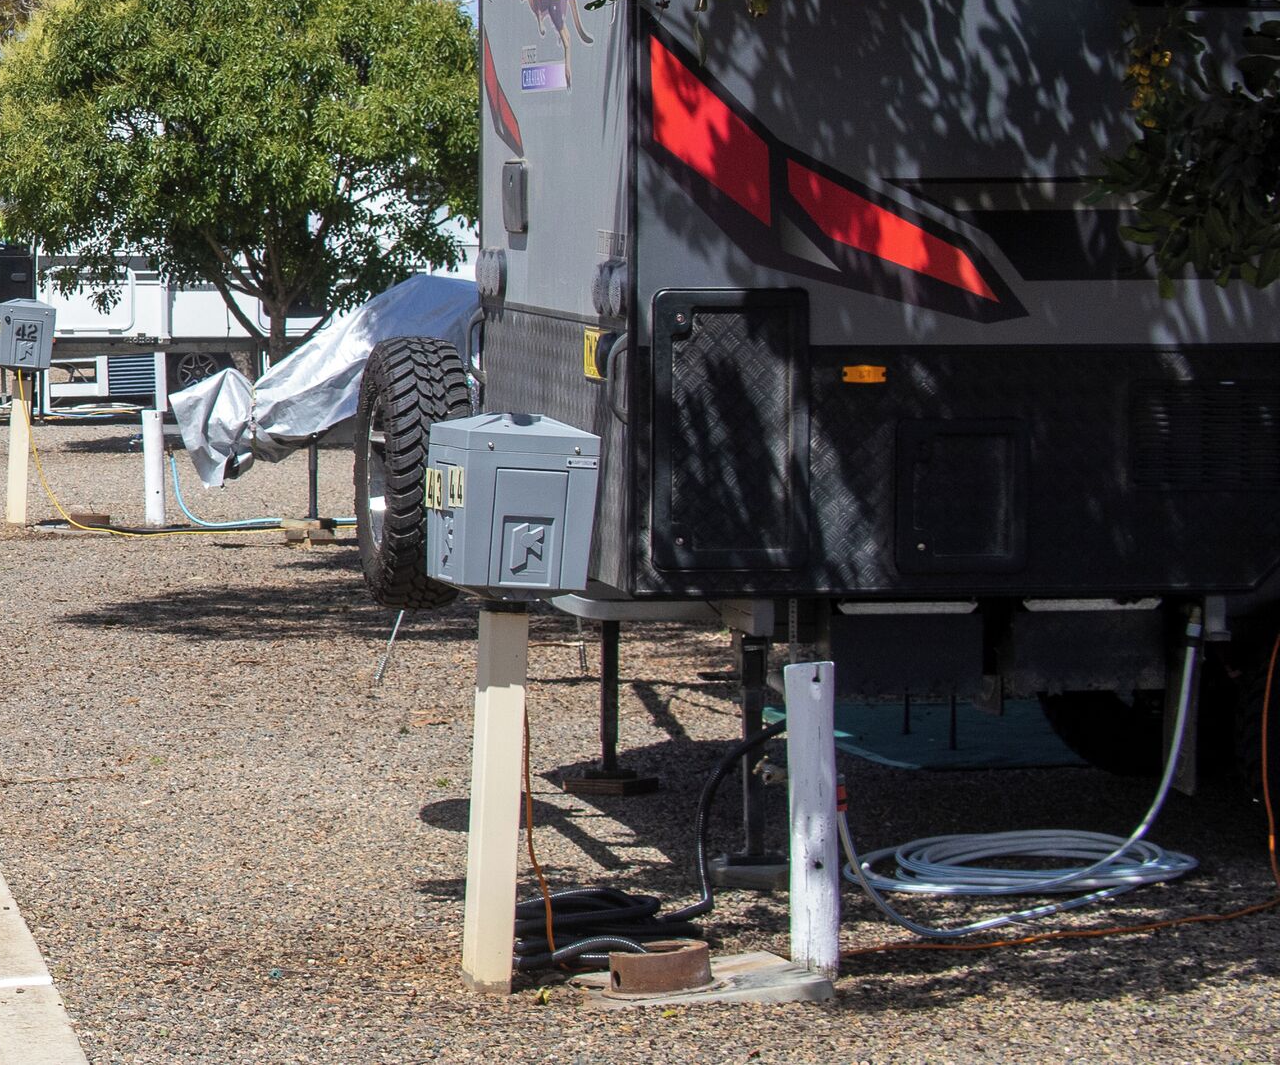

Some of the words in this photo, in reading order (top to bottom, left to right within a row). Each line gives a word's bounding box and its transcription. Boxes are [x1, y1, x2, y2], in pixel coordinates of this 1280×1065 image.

[15, 324, 38, 339] 42
[427, 470, 442, 507] 43
[449, 469, 462, 500] 44
